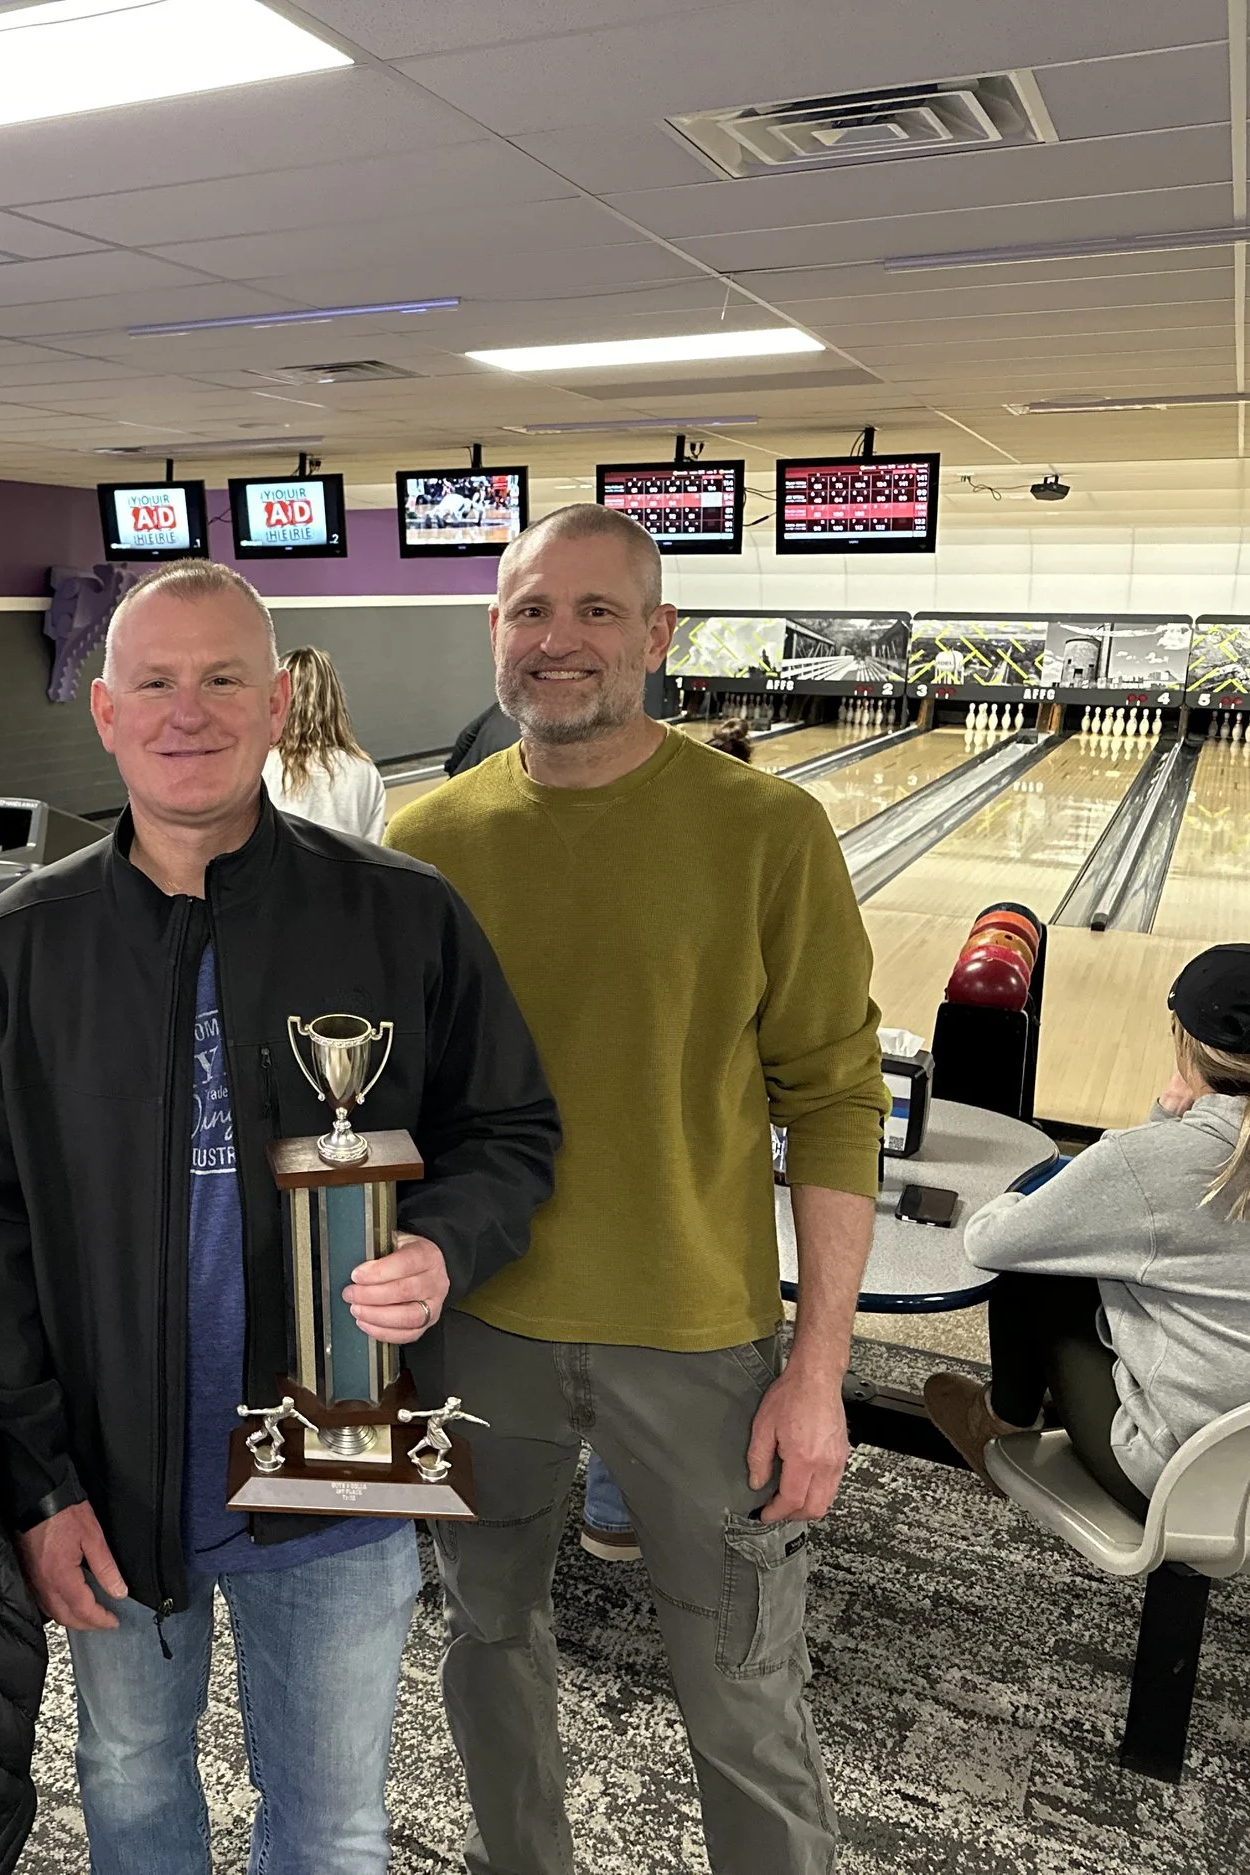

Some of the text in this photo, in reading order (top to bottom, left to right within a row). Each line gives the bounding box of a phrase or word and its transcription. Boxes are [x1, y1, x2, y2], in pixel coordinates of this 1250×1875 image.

[130, 494, 170, 505] YOUR
[263, 488, 306, 500] YOUR
[138, 507, 174, 529] AD
[270, 501, 311, 524] AD
[137, 532, 174, 544] HERE
[269, 528, 310, 540] HERE
[676, 677, 683, 688] 1
[766, 680, 794, 691] AFFC
[882, 683, 893, 694] 2
[916, 685, 928, 697] 3
[1023, 688, 1056, 700] AFFC
[1158, 692, 1170, 705] 4
[1198, 694, 1210, 706] 5
